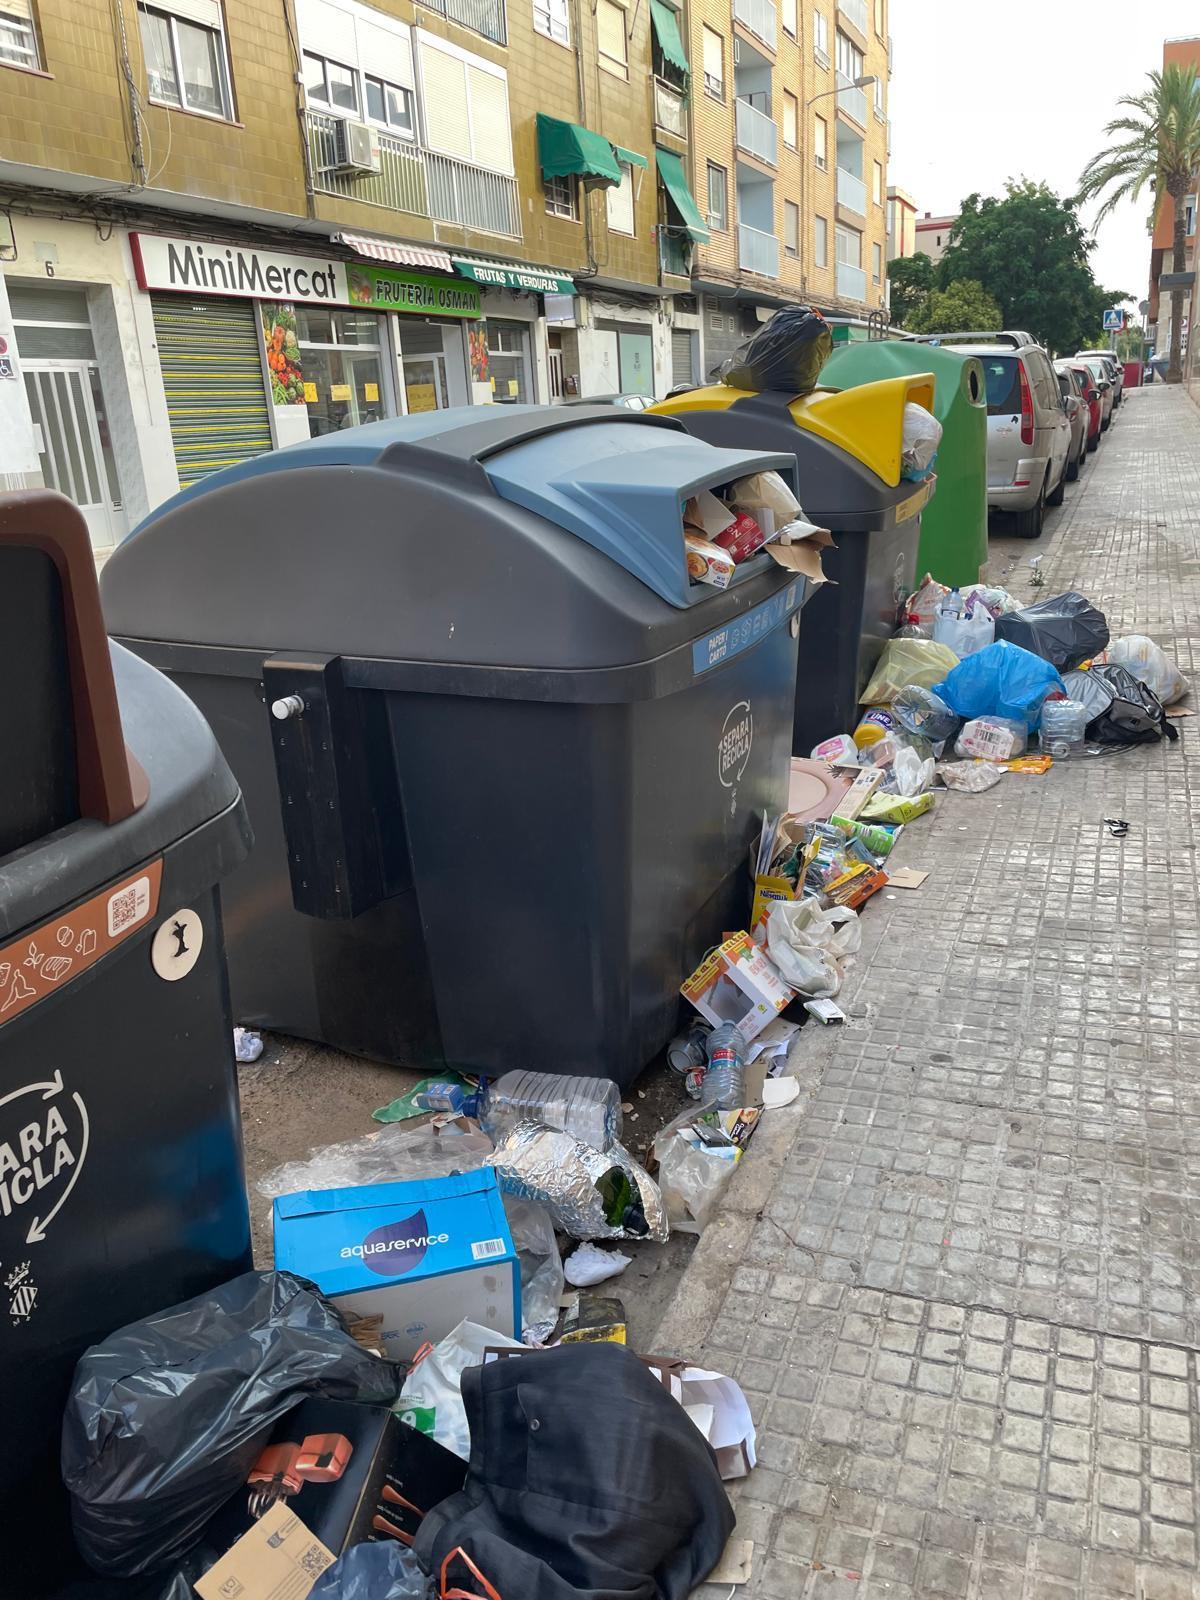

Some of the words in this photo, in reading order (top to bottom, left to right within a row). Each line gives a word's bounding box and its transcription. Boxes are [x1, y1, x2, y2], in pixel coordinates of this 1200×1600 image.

[45, 261, 55, 277] 6
[168, 243, 337, 299] MiniMercat
[473, 267, 507, 284] FRUTAS
[508, 273, 515, 285] Y
[517, 274, 559, 291] VERDURAS
[438, 288, 477, 312] OSMAN
[708, 631, 726, 652] PAPER
[722, 716, 750, 754] SEPARA
[722, 735, 750, 773] RECICLA
[0, 1137, 76, 1217] ICLA
[340, 1232, 450, 1260] aquaservice
